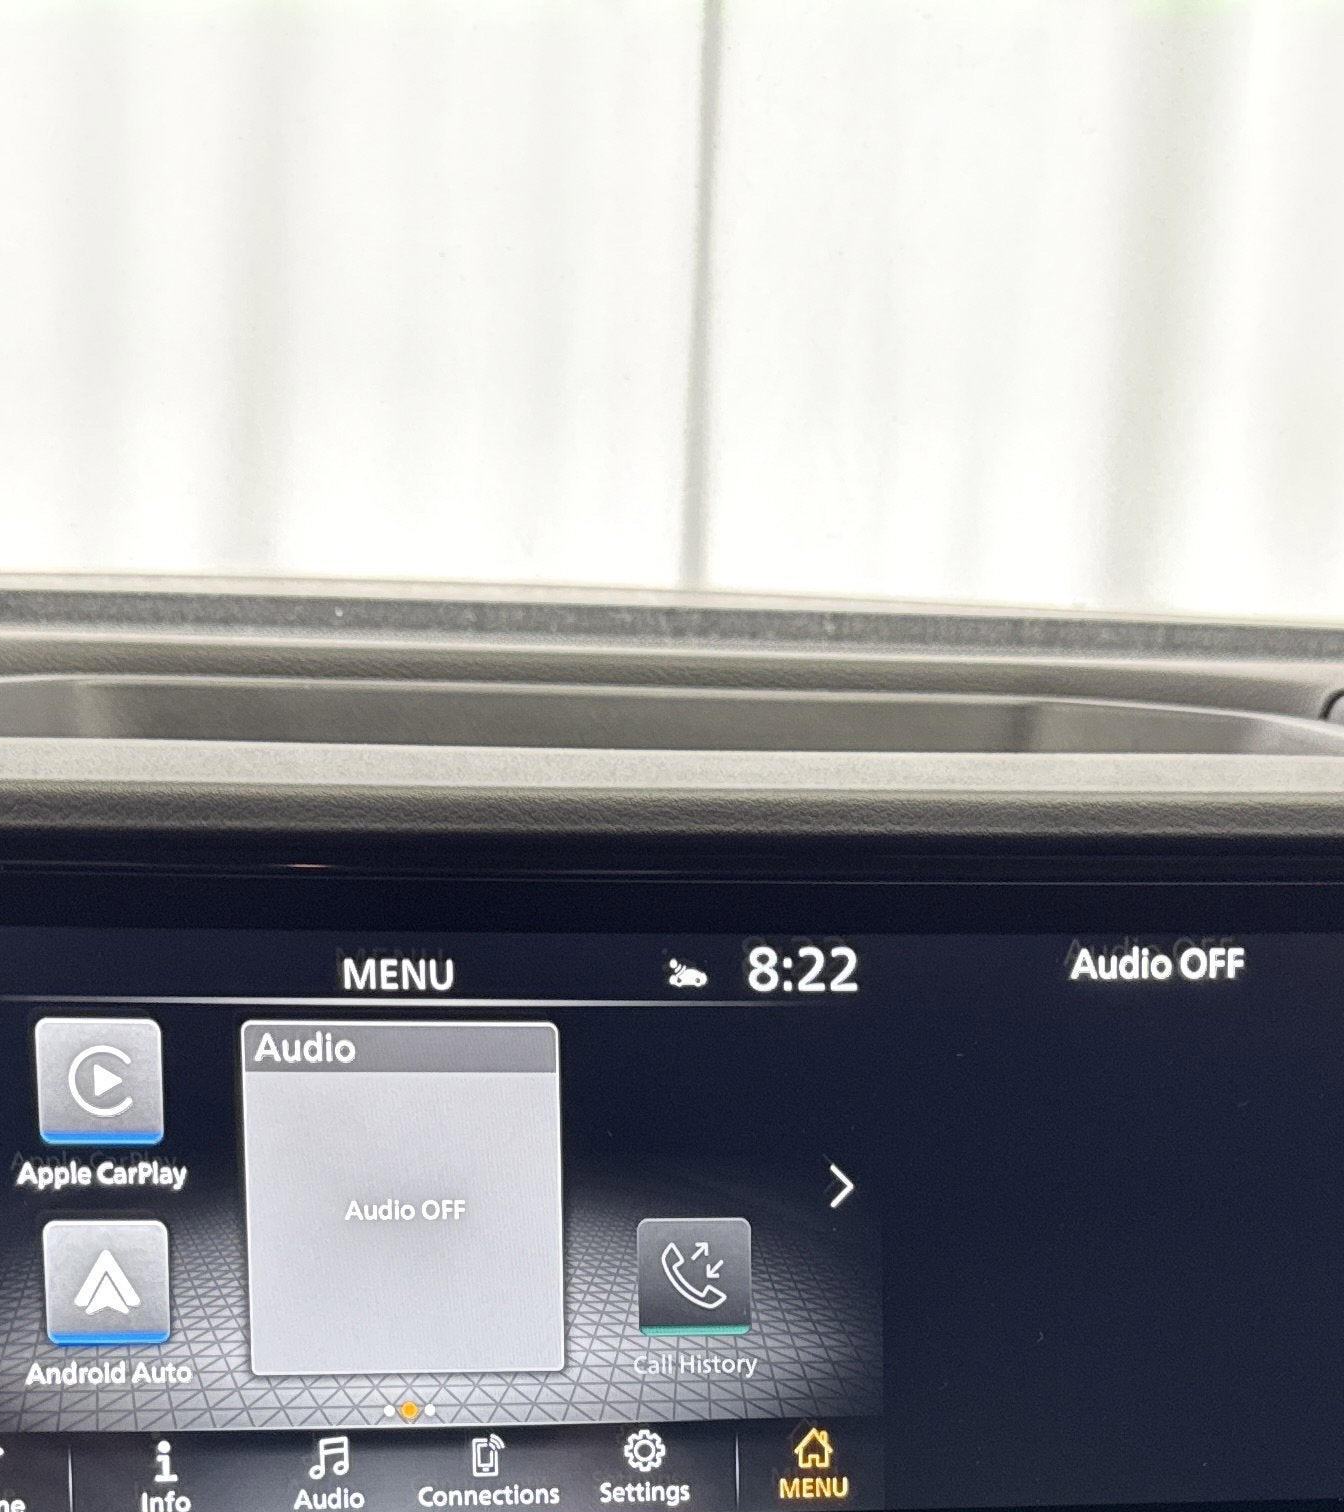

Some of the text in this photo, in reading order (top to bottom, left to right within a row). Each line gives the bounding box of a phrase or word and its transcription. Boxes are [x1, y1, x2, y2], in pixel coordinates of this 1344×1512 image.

[342, 958, 454, 991] MENU
[748, 946, 858, 992] 8:22
[1069, 945, 1245, 980] Audio OFF
[255, 1032, 355, 1064] Audio
[16, 1161, 187, 1191] Apple CarPlay
[345, 1200, 465, 1222] Audio OFF
[26, 1360, 193, 1386] Android Auto
[633, 1354, 757, 1378] Call History
[294, 1488, 365, 1511] Audio
[418, 1484, 560, 1508] Connections
[600, 1482, 690, 1507] Settings
[780, 1477, 849, 1500] MENU
